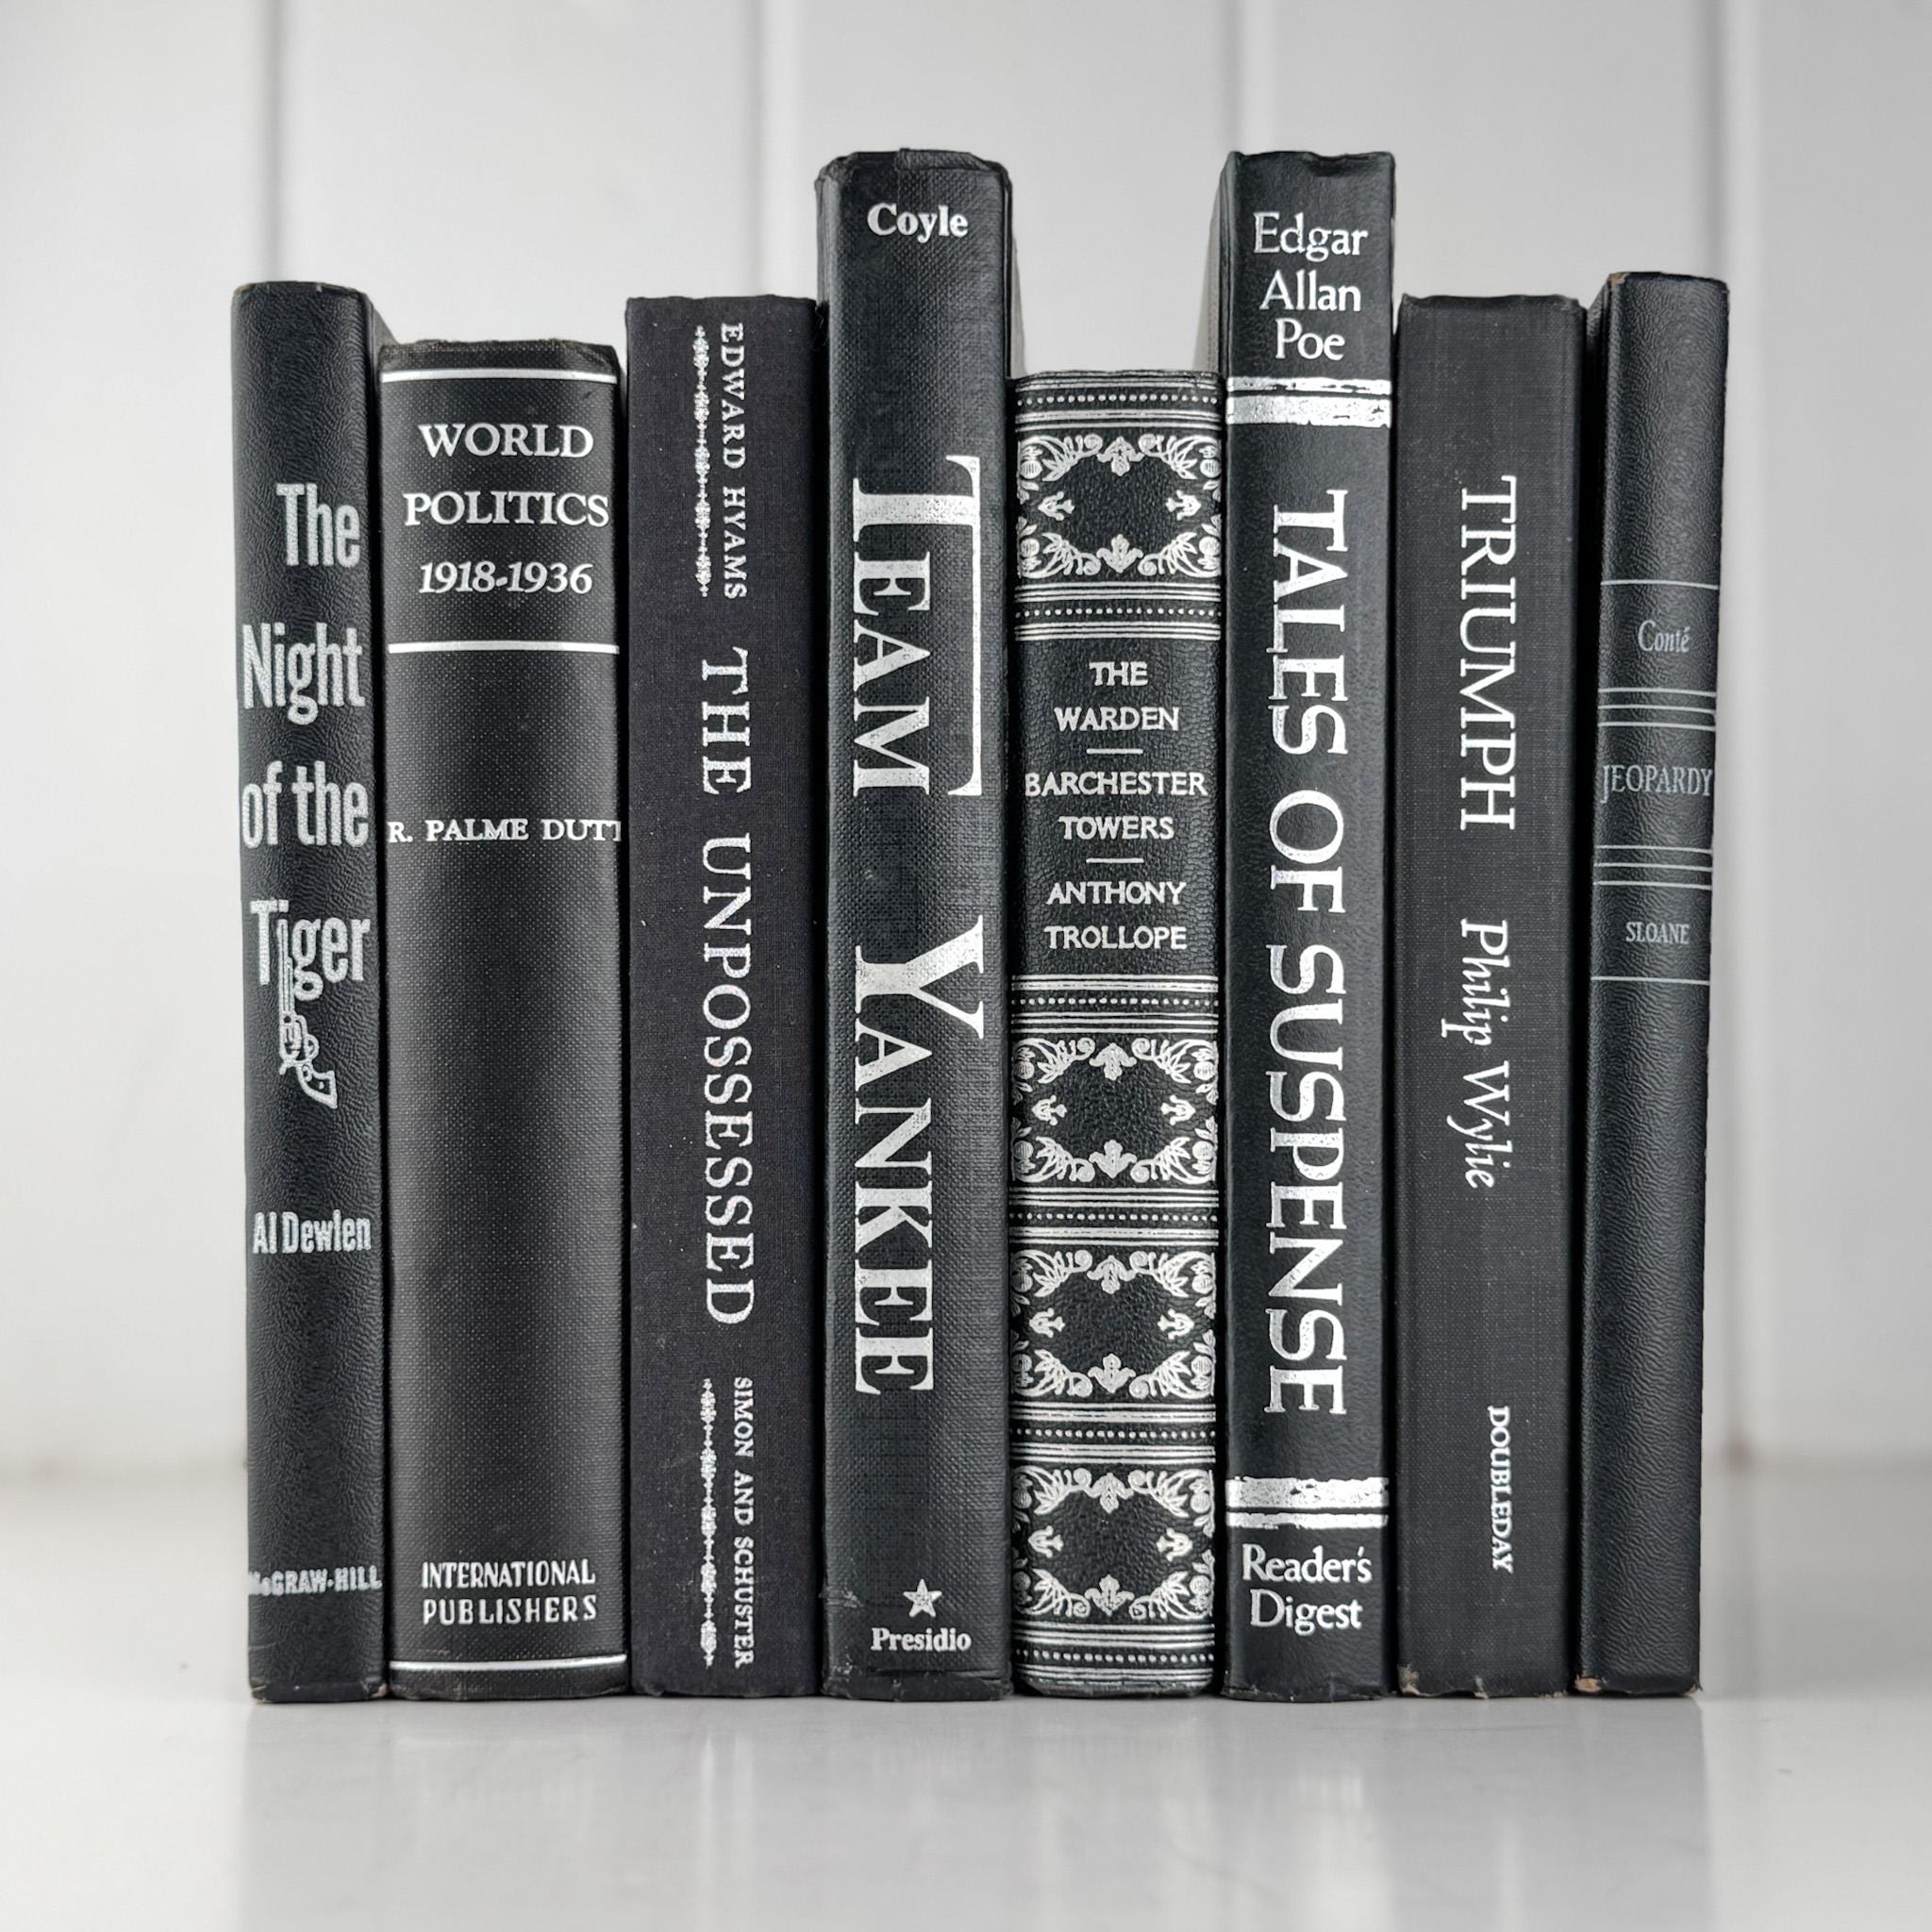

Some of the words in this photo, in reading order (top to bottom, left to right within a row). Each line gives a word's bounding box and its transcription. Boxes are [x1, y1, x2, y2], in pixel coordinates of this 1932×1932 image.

[867, 202, 969, 243] Coyle
[1254, 211, 1369, 262] Edgar
[1259, 269, 1362, 312] Allan
[1275, 317, 1346, 361] Poe
[720, 322, 746, 469] EDWARD
[417, 423, 594, 458] WORLD
[275, 482, 361, 569] The
[401, 491, 609, 528] POLITICS
[722, 486, 748, 599] HYAMS
[418, 560, 594, 594] 1918-1936
[852, 454, 983, 797] TEAM
[1266, 489, 1349, 755] TALES
[1637, 618, 1692, 653] Conté
[241, 621, 366, 726] Night
[1089, 660, 1149, 687] THE
[1459, 475, 1517, 831] TRIUMPH
[701, 646, 752, 795] THE
[1053, 706, 1180, 732] WARDEN
[241, 760, 283, 851] of
[291, 759, 370, 848] the
[1024, 771, 1209, 797] BARCHESTER
[1601, 764, 1714, 804] JEOPARDY
[387, 821, 414, 843] R.
[424, 818, 529, 842] PALME
[1058, 815, 1175, 841] TOWERS
[1269, 790, 1346, 914] OF
[1045, 880, 1188, 906] ANTHONY
[247, 896, 372, 1003] Tiger
[1043, 924, 1189, 951] TROLLOPE
[1624, 921, 1690, 944] SLOANE
[1441, 918, 1511, 1046] Philip
[702, 832, 755, 1324] UNPOSSESSED
[1446, 1059, 1513, 1189] Wylie
[854, 913, 984, 1395] YANKEE
[1265, 943, 1348, 1415] SUSPENSE
[251, 1211, 277, 1255] Al
[281, 1208, 373, 1254] Dewlen
[733, 1376, 754, 1457] SIMON
[733, 1469, 755, 1525] AND
[1487, 1405, 1513, 1574] DOUBLEDAY
[421, 1558, 596, 1590] INTERNATIONAL
[1242, 1543, 1373, 1584] Reader's
[423, 1594, 597, 1625] PUBLISHERS
[733, 1536, 755, 1669] SCHUSTER
[1250, 1589, 1363, 1636] Digest
[870, 1627, 973, 1653] Presidio
